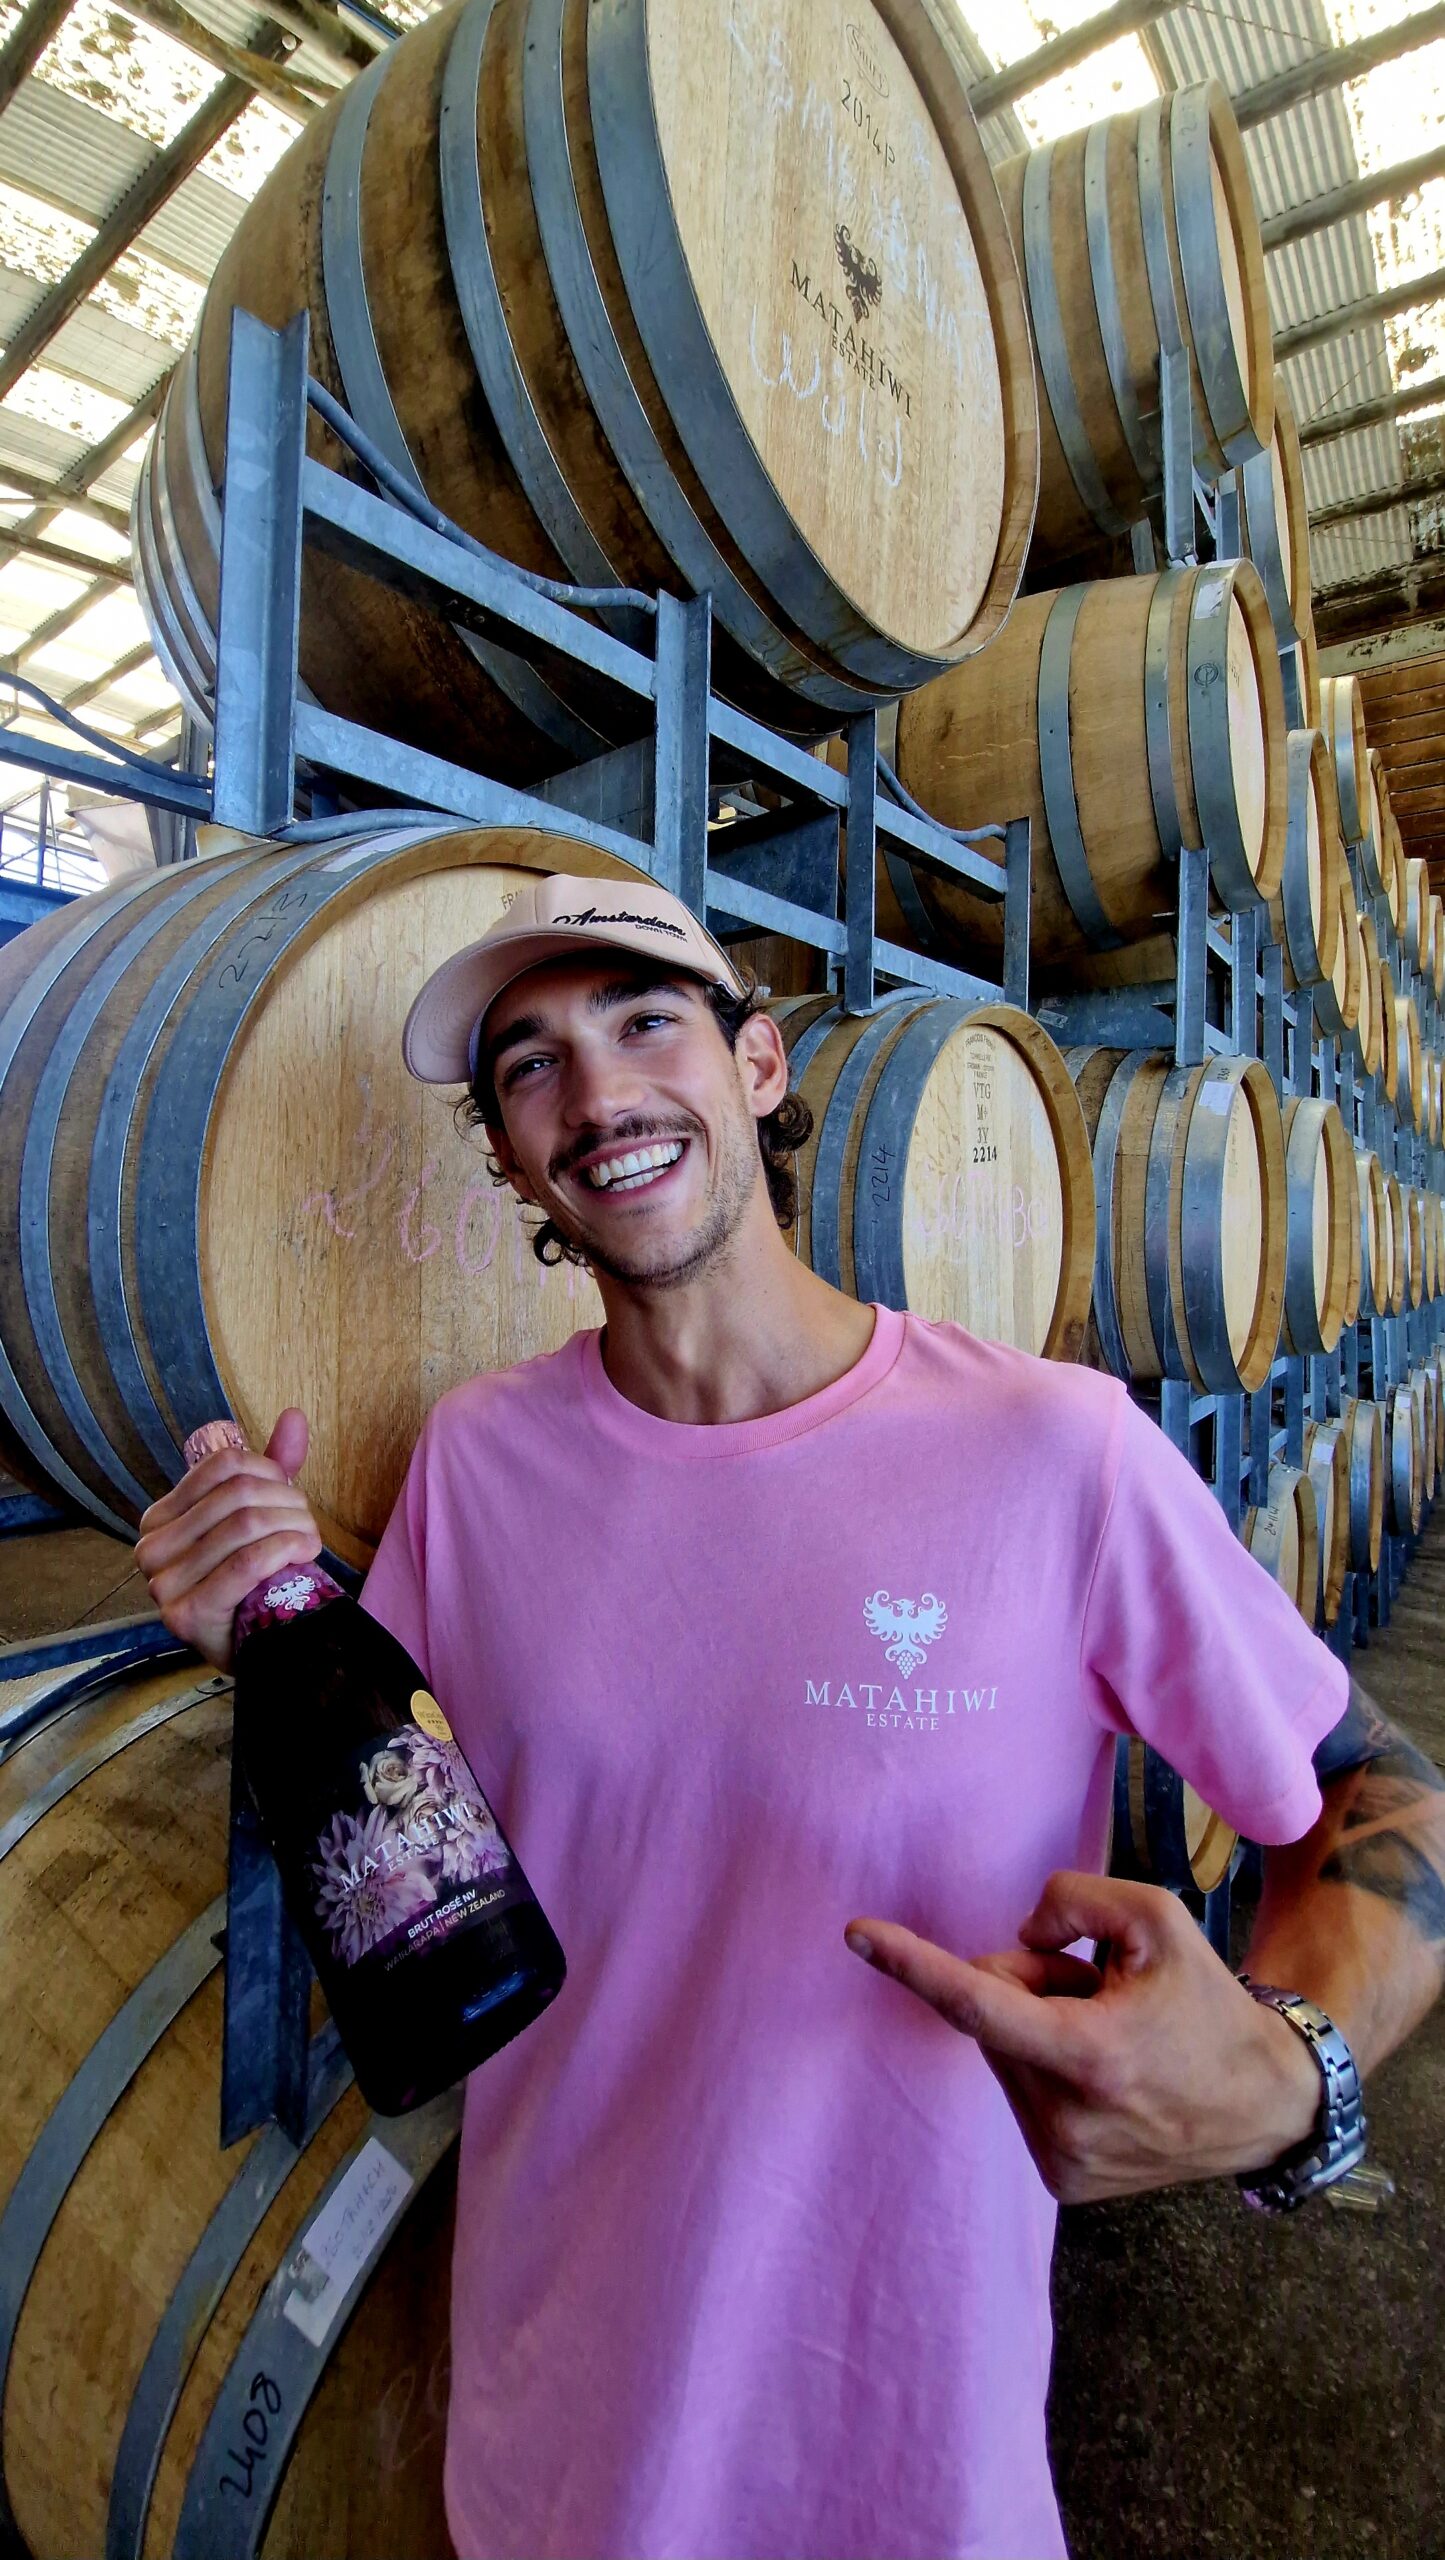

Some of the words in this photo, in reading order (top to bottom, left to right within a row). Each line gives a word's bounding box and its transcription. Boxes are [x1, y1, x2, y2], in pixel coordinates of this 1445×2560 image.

[789, 259, 912, 419] MATAHIWI
[832, 335, 876, 391] ESTATE
[552, 908, 687, 936] Amsterdam
[973, 1082, 991, 1099] VTG
[973, 1145, 998, 1163] 2214
[977, 1127, 989, 1143] 3Y
[871, 1144, 896, 1208] 2214
[804, 1679, 998, 1714] MATAHIWI
[867, 1713, 940, 1730] ESTATE
[338, 1802, 475, 1892] MATAHIWI
[388, 1834, 440, 1872] ESTATE
[407, 1914, 435, 1939] BRUT
[434, 1895, 463, 1920] ROSÉ
[461, 1889, 477, 1903] NV
[445, 1908, 468, 1928] NEW
[468, 1889, 506, 1914] ZEALAND
[219, 2371, 282, 2498] 2408
